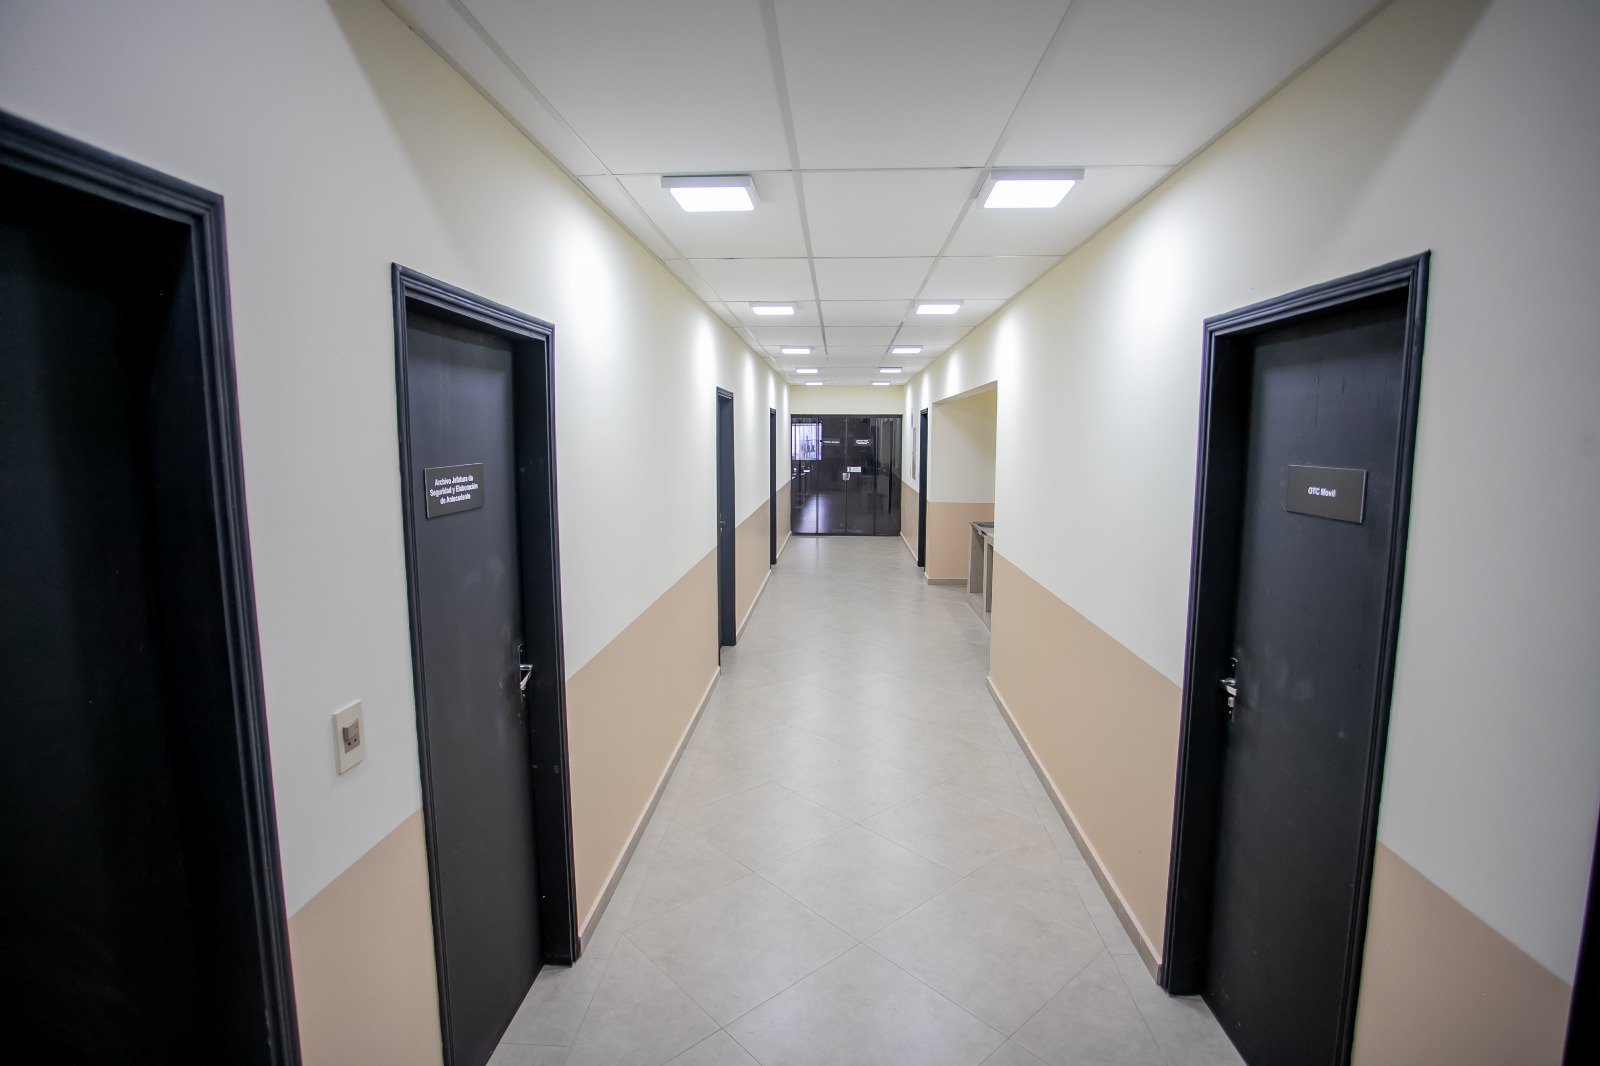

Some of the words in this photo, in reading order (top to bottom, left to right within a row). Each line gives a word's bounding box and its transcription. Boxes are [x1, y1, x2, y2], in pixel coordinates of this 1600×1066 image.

[435, 478, 451, 486] Archivo
[430, 486, 452, 497] Seguridad
[1308, 486, 1320, 496] OTC
